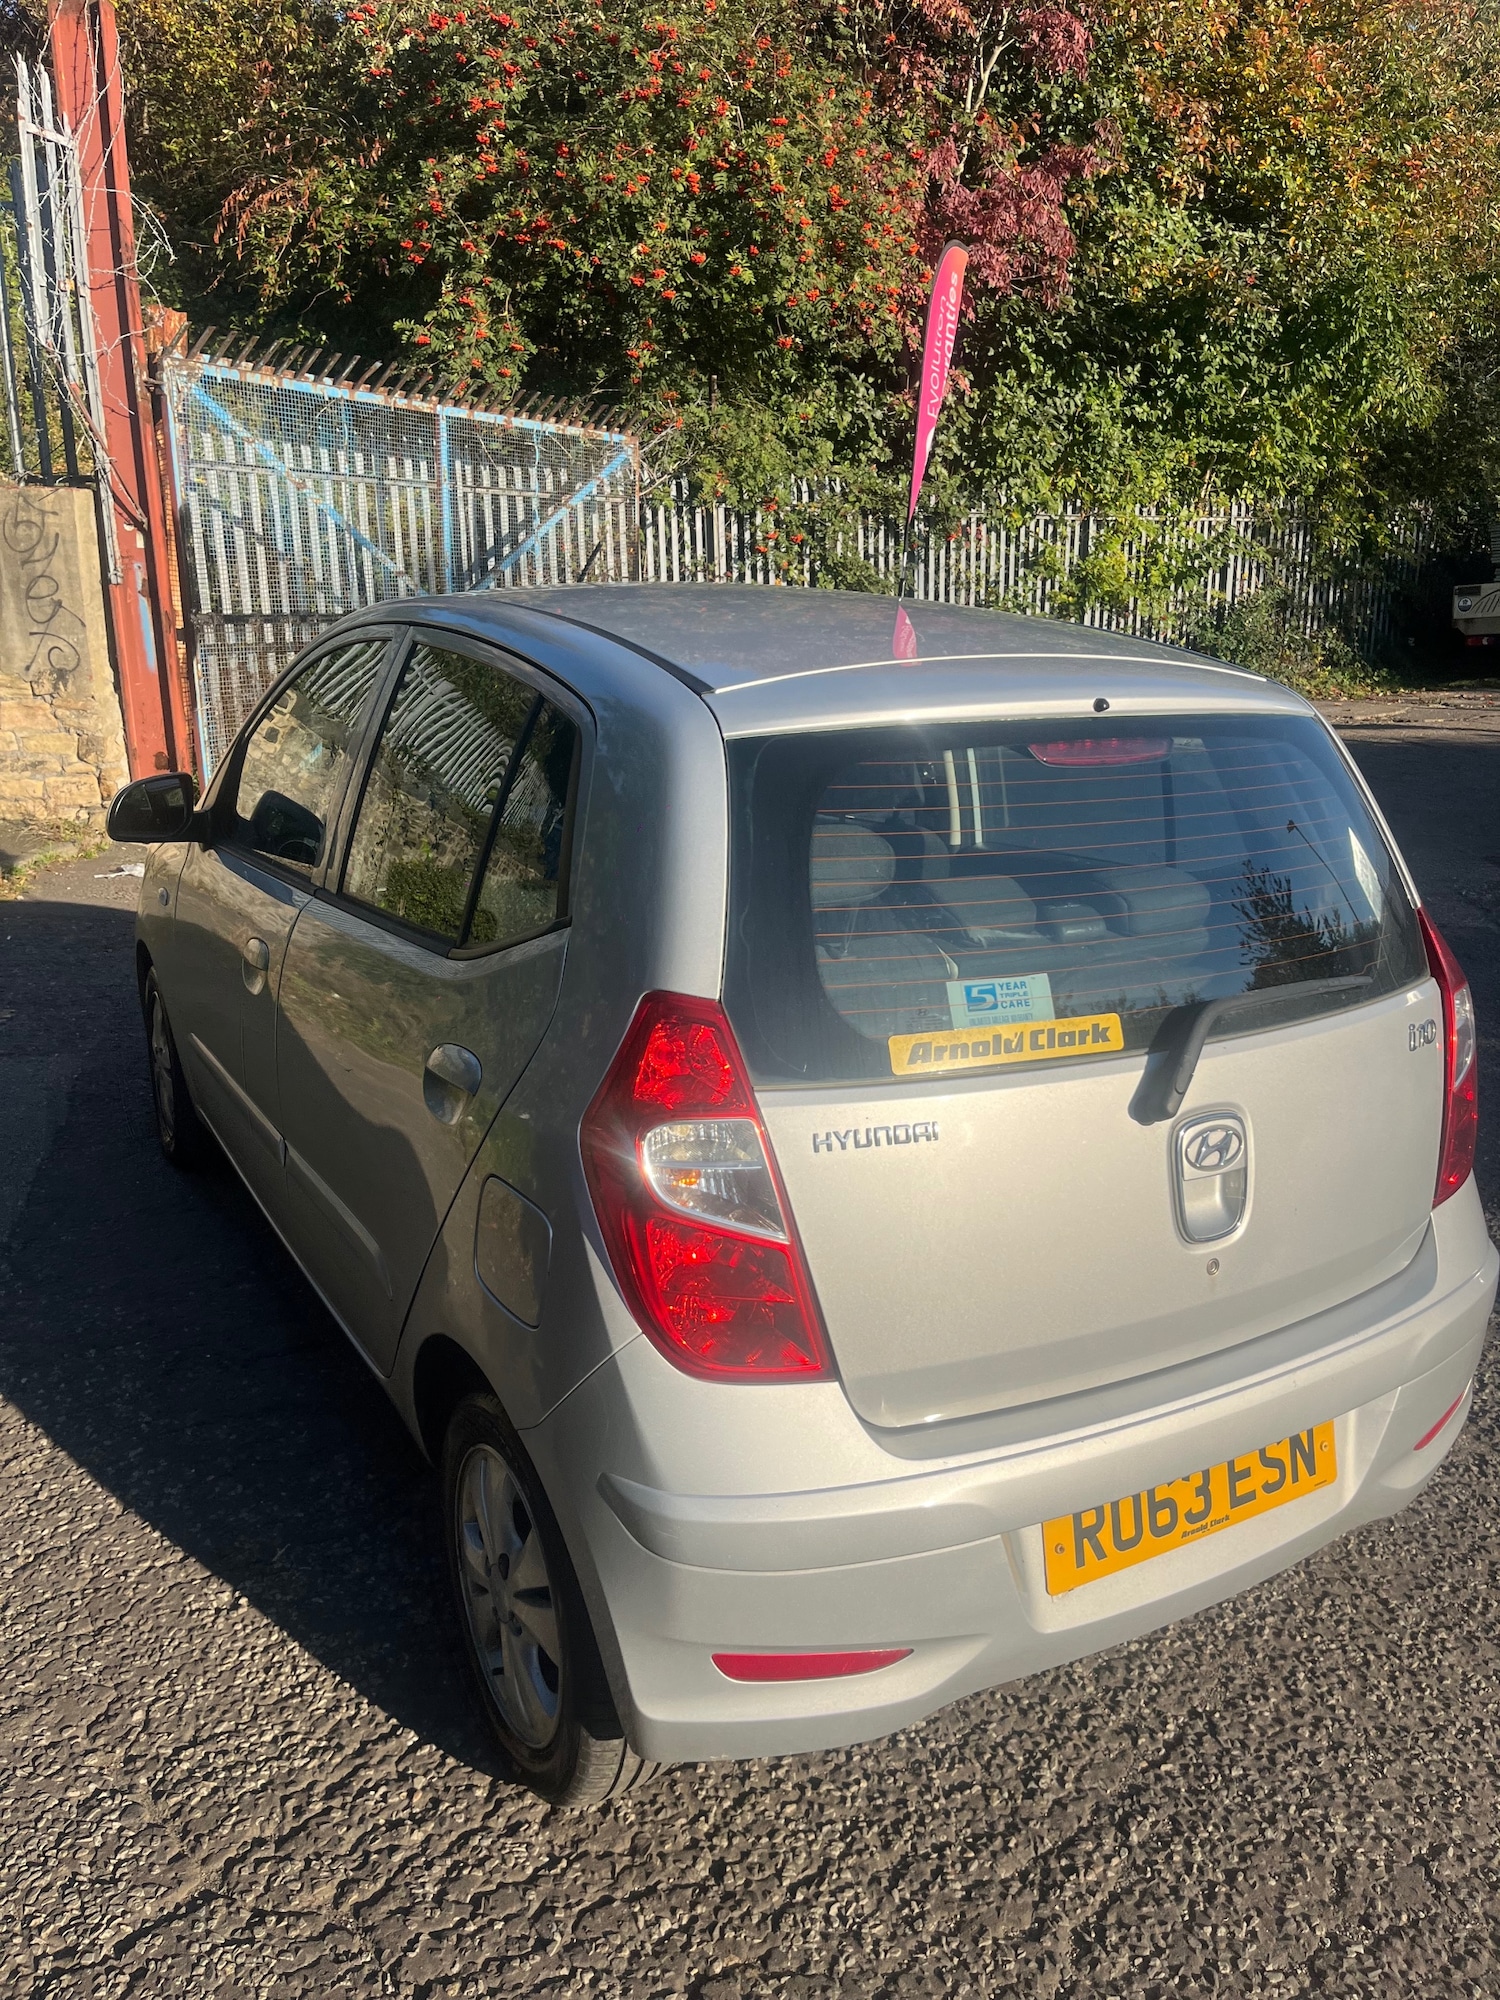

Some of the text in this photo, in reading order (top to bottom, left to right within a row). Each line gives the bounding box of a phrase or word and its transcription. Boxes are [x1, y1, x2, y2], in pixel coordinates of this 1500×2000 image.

[927, 295, 947, 419] Evolution
[968, 984, 996, 1010] 5
[998, 981, 1027, 991] YEAR
[1000, 991, 1029, 999] TRIPLE
[1001, 999, 1031, 1009] CARE
[906, 1023, 1111, 1065] Arnold Clark
[1408, 1018, 1437, 1052] i10
[812, 1121, 939, 1153] HYUNDAI
[1226, 1427, 1316, 1510] ESN
